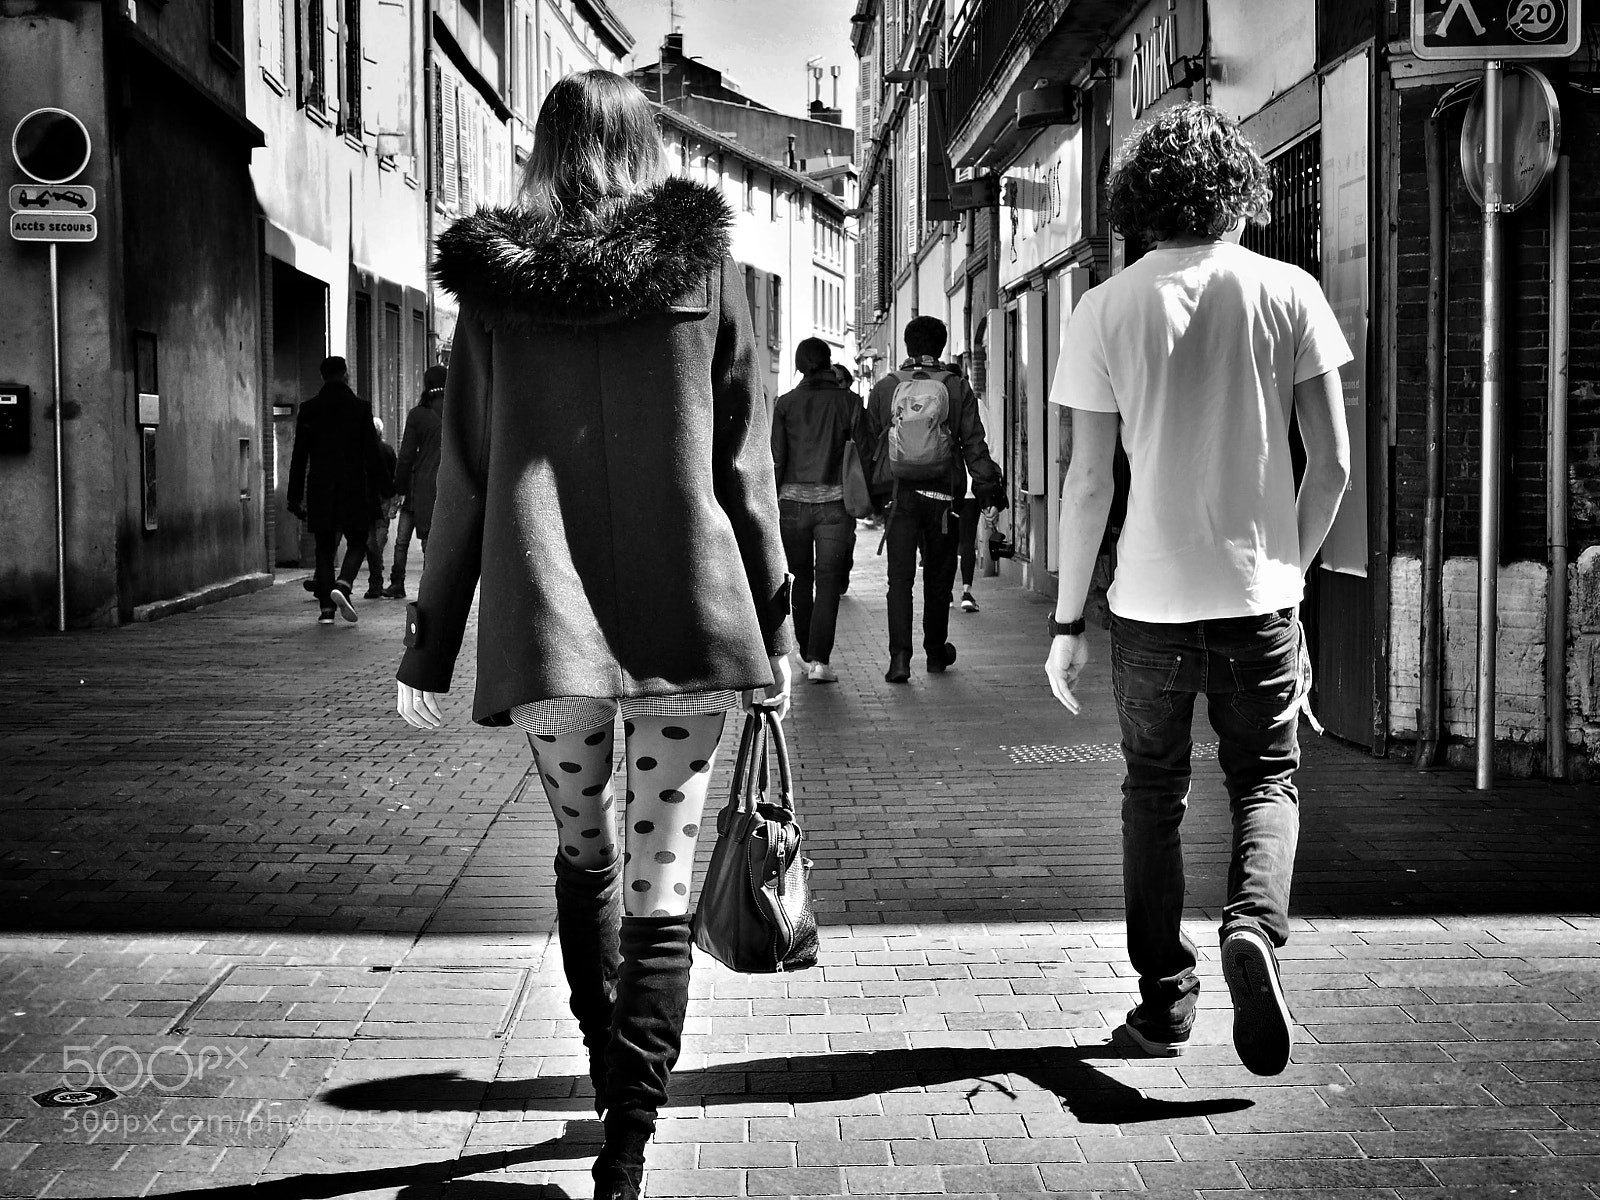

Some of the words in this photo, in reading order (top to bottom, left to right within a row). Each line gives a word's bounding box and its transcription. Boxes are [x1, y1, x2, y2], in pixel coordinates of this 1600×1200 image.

[1520, 3, 1552, 24] 20
[15, 221, 45, 231] ACCÈS
[49, 223, 92, 232] SECOURS
